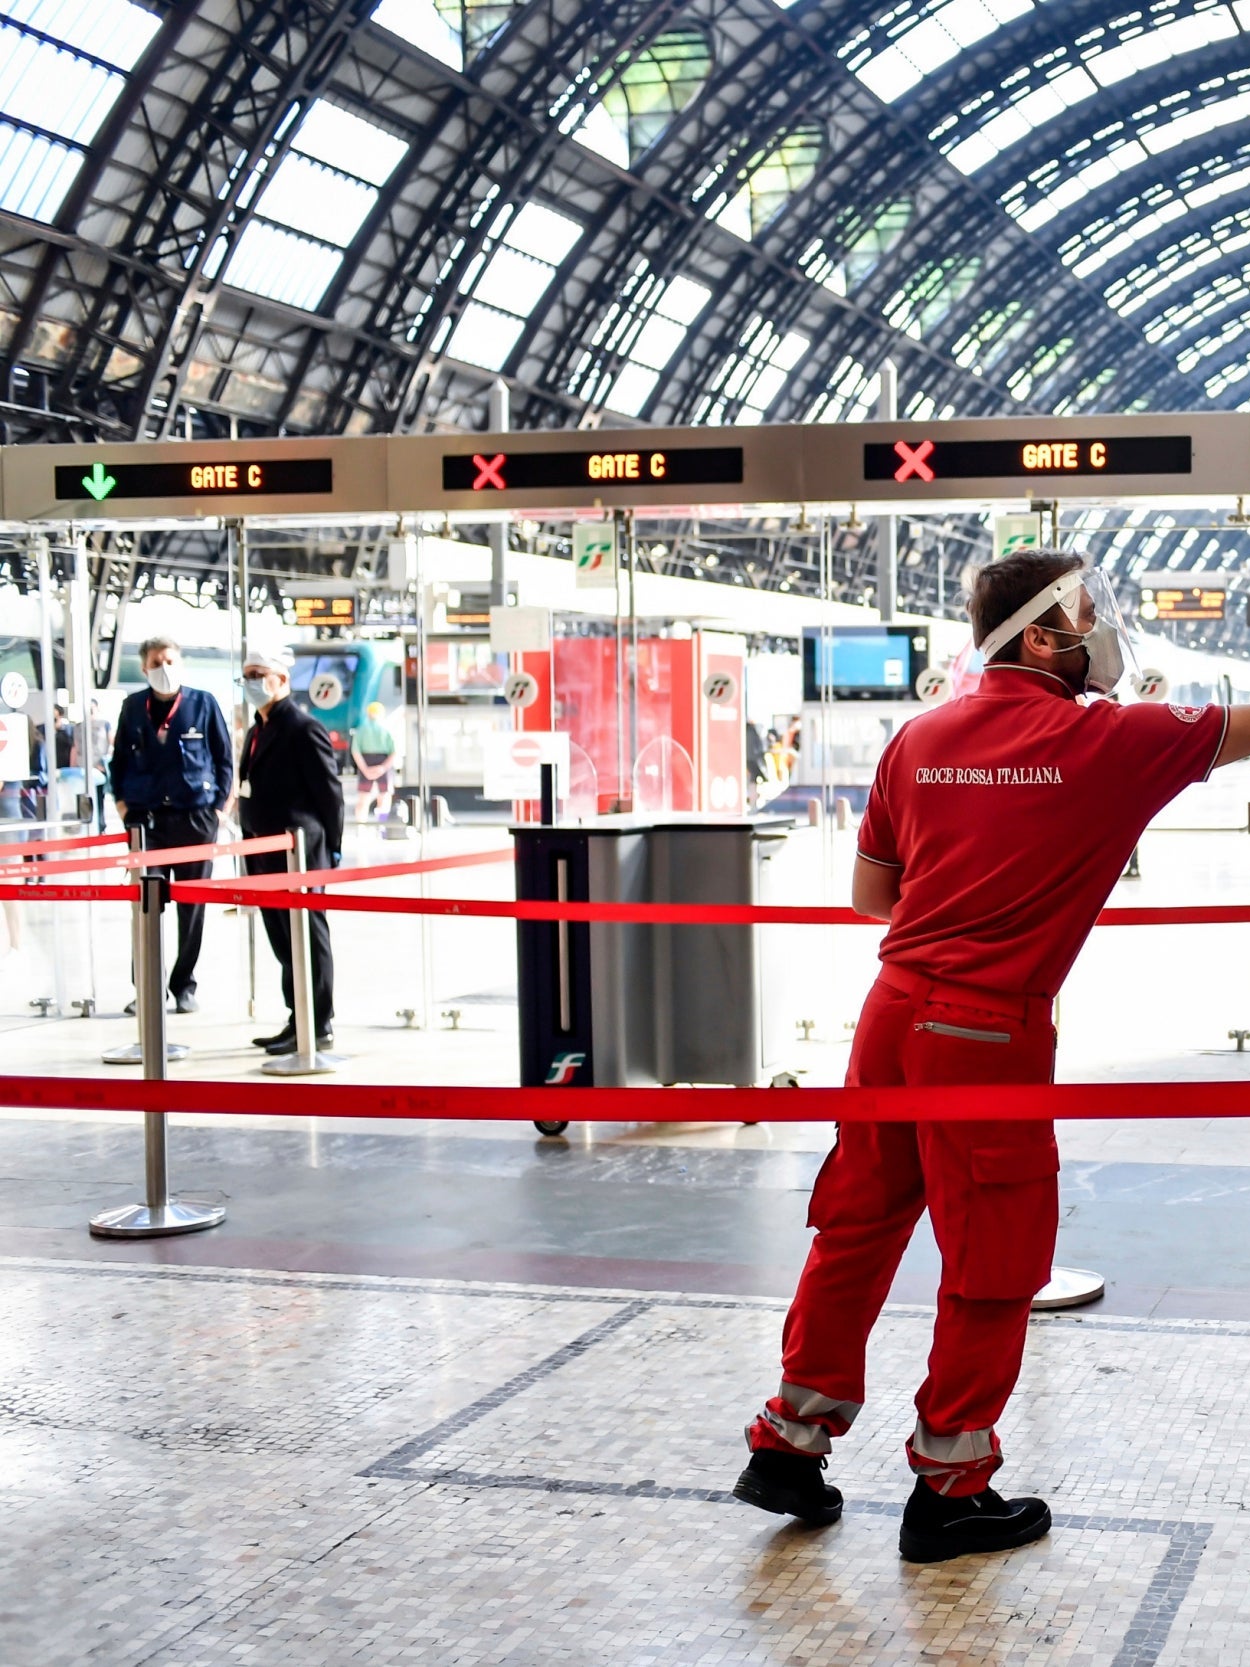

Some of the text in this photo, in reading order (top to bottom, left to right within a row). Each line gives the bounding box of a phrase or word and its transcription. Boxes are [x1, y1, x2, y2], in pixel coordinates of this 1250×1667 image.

[588, 452, 665, 479] GATE C
[1022, 442, 1106, 469] GATE C
[190, 464, 262, 489] GATE C
[915, 767, 1063, 785] CROCE ROSSA ITALIANA
